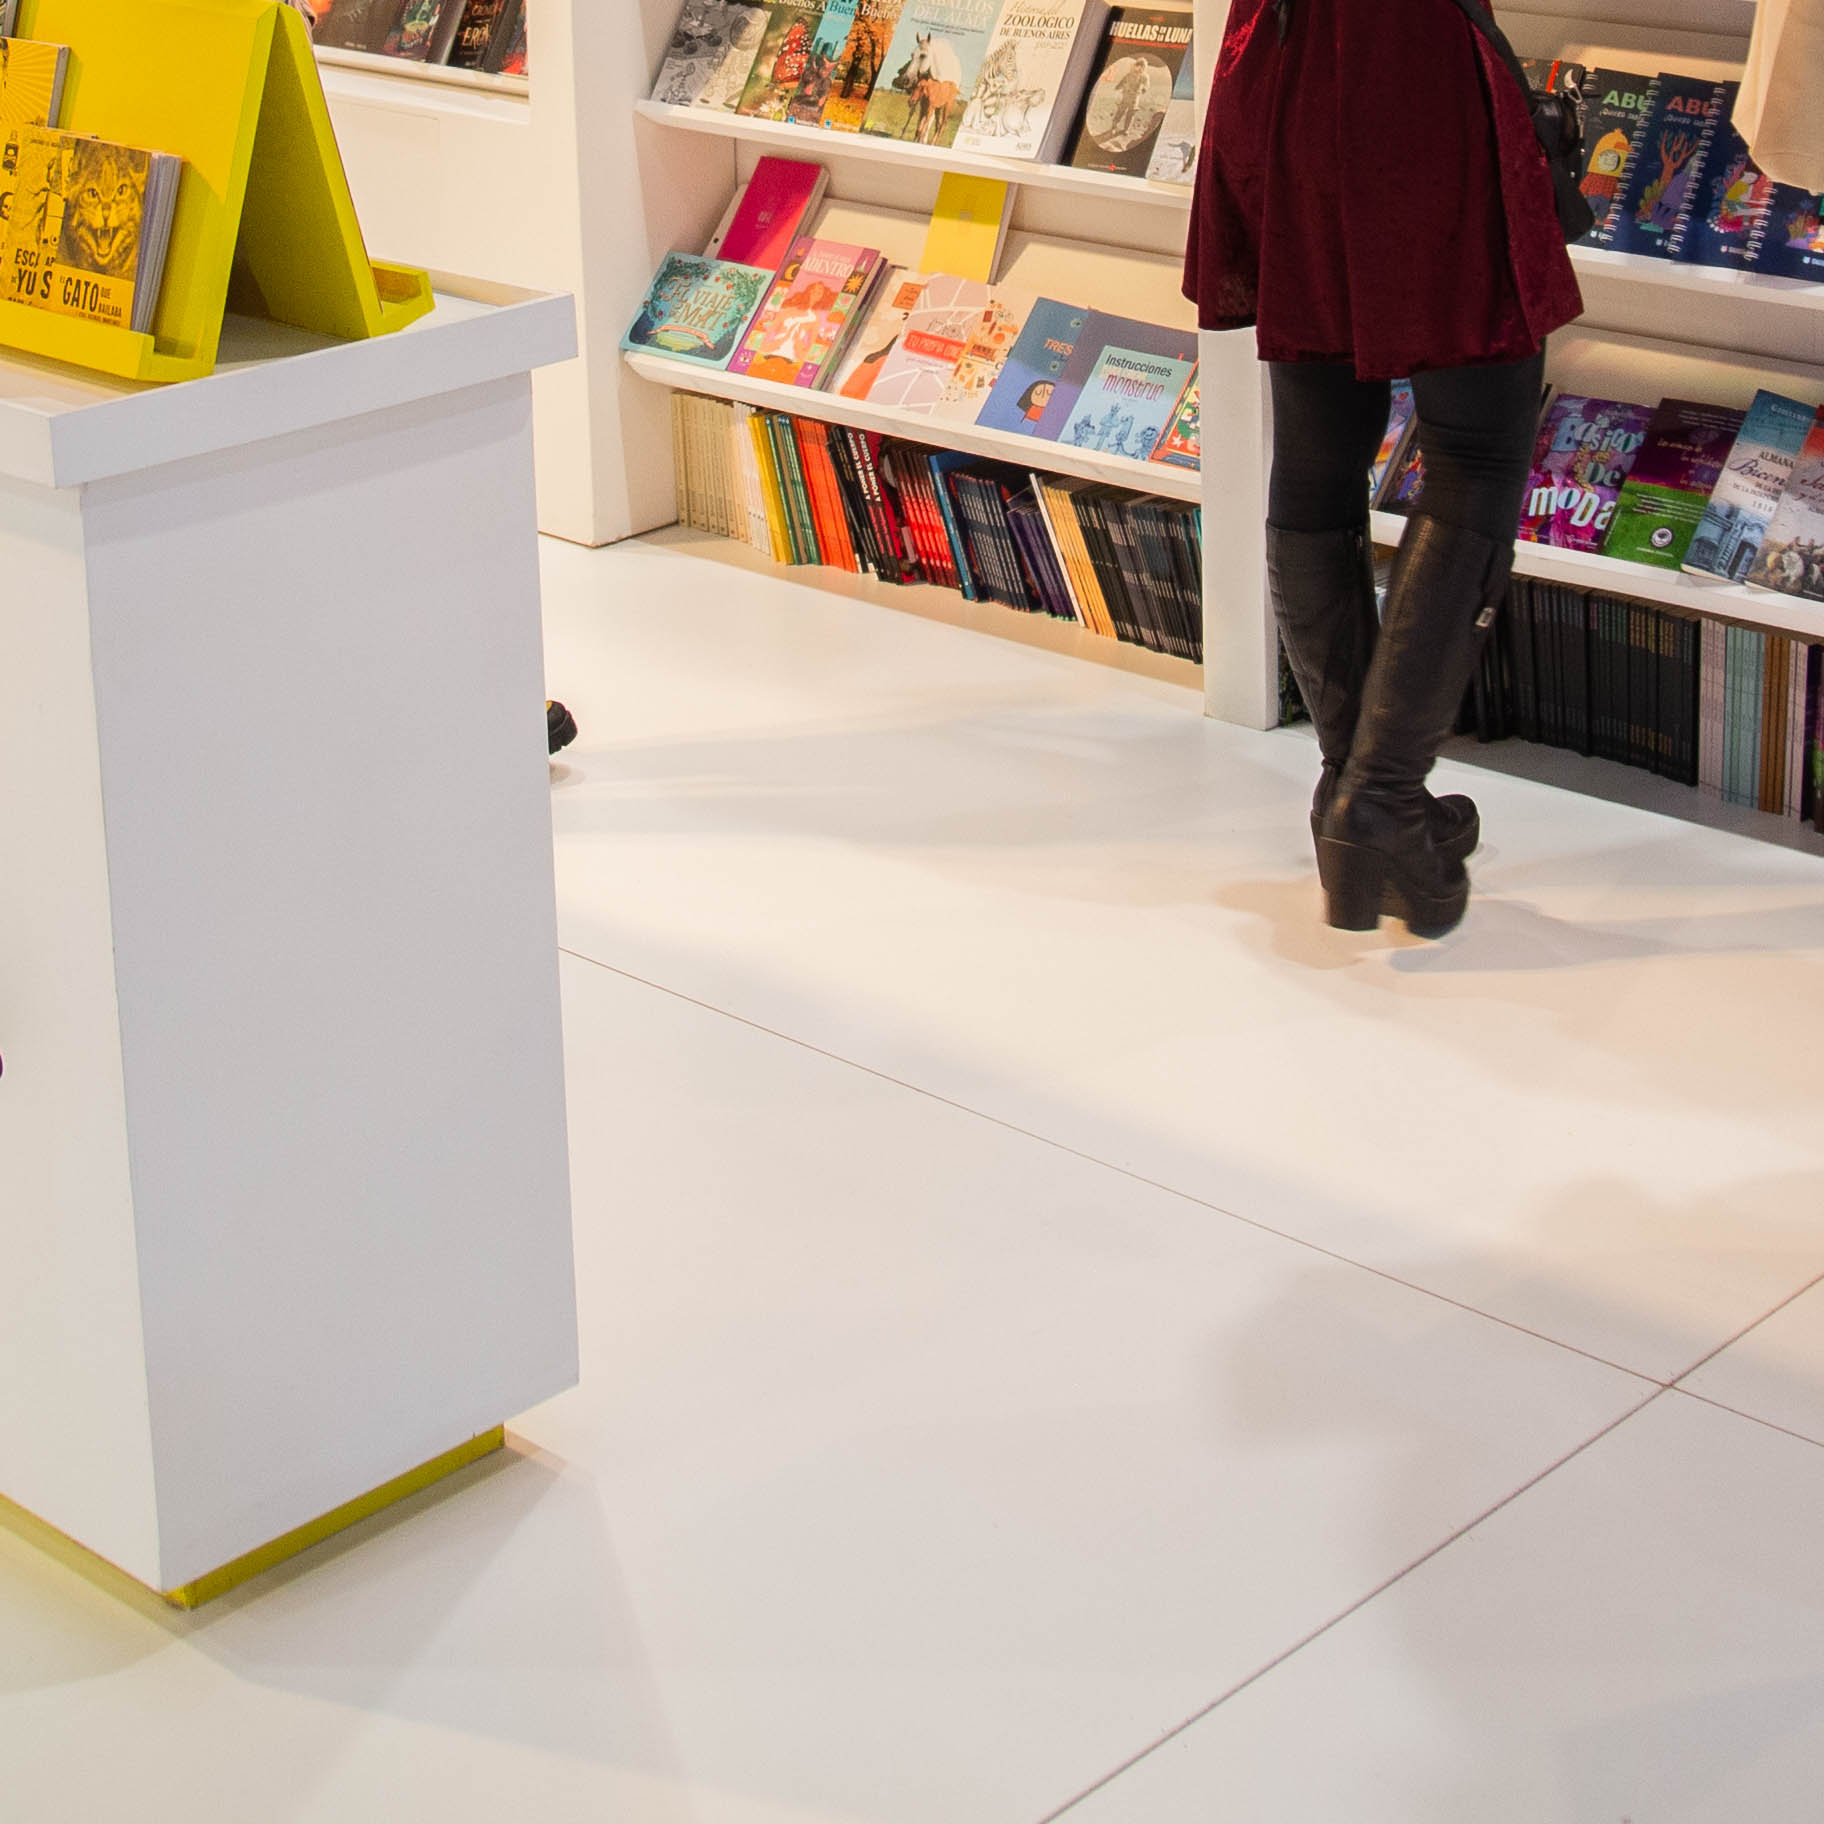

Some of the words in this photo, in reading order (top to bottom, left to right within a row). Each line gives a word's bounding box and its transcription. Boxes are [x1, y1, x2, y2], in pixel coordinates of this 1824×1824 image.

[999, 28, 1010, 37] DE
[1012, 28, 1047, 39] BUENOS
[1048, 29, 1071, 40] AIRES
[802, 258, 855, 277] ADENTRO
[63, 277, 99, 312] GATO
[1043, 338, 1074, 356] TRES
[1106, 354, 1173, 377] Instrucciones
